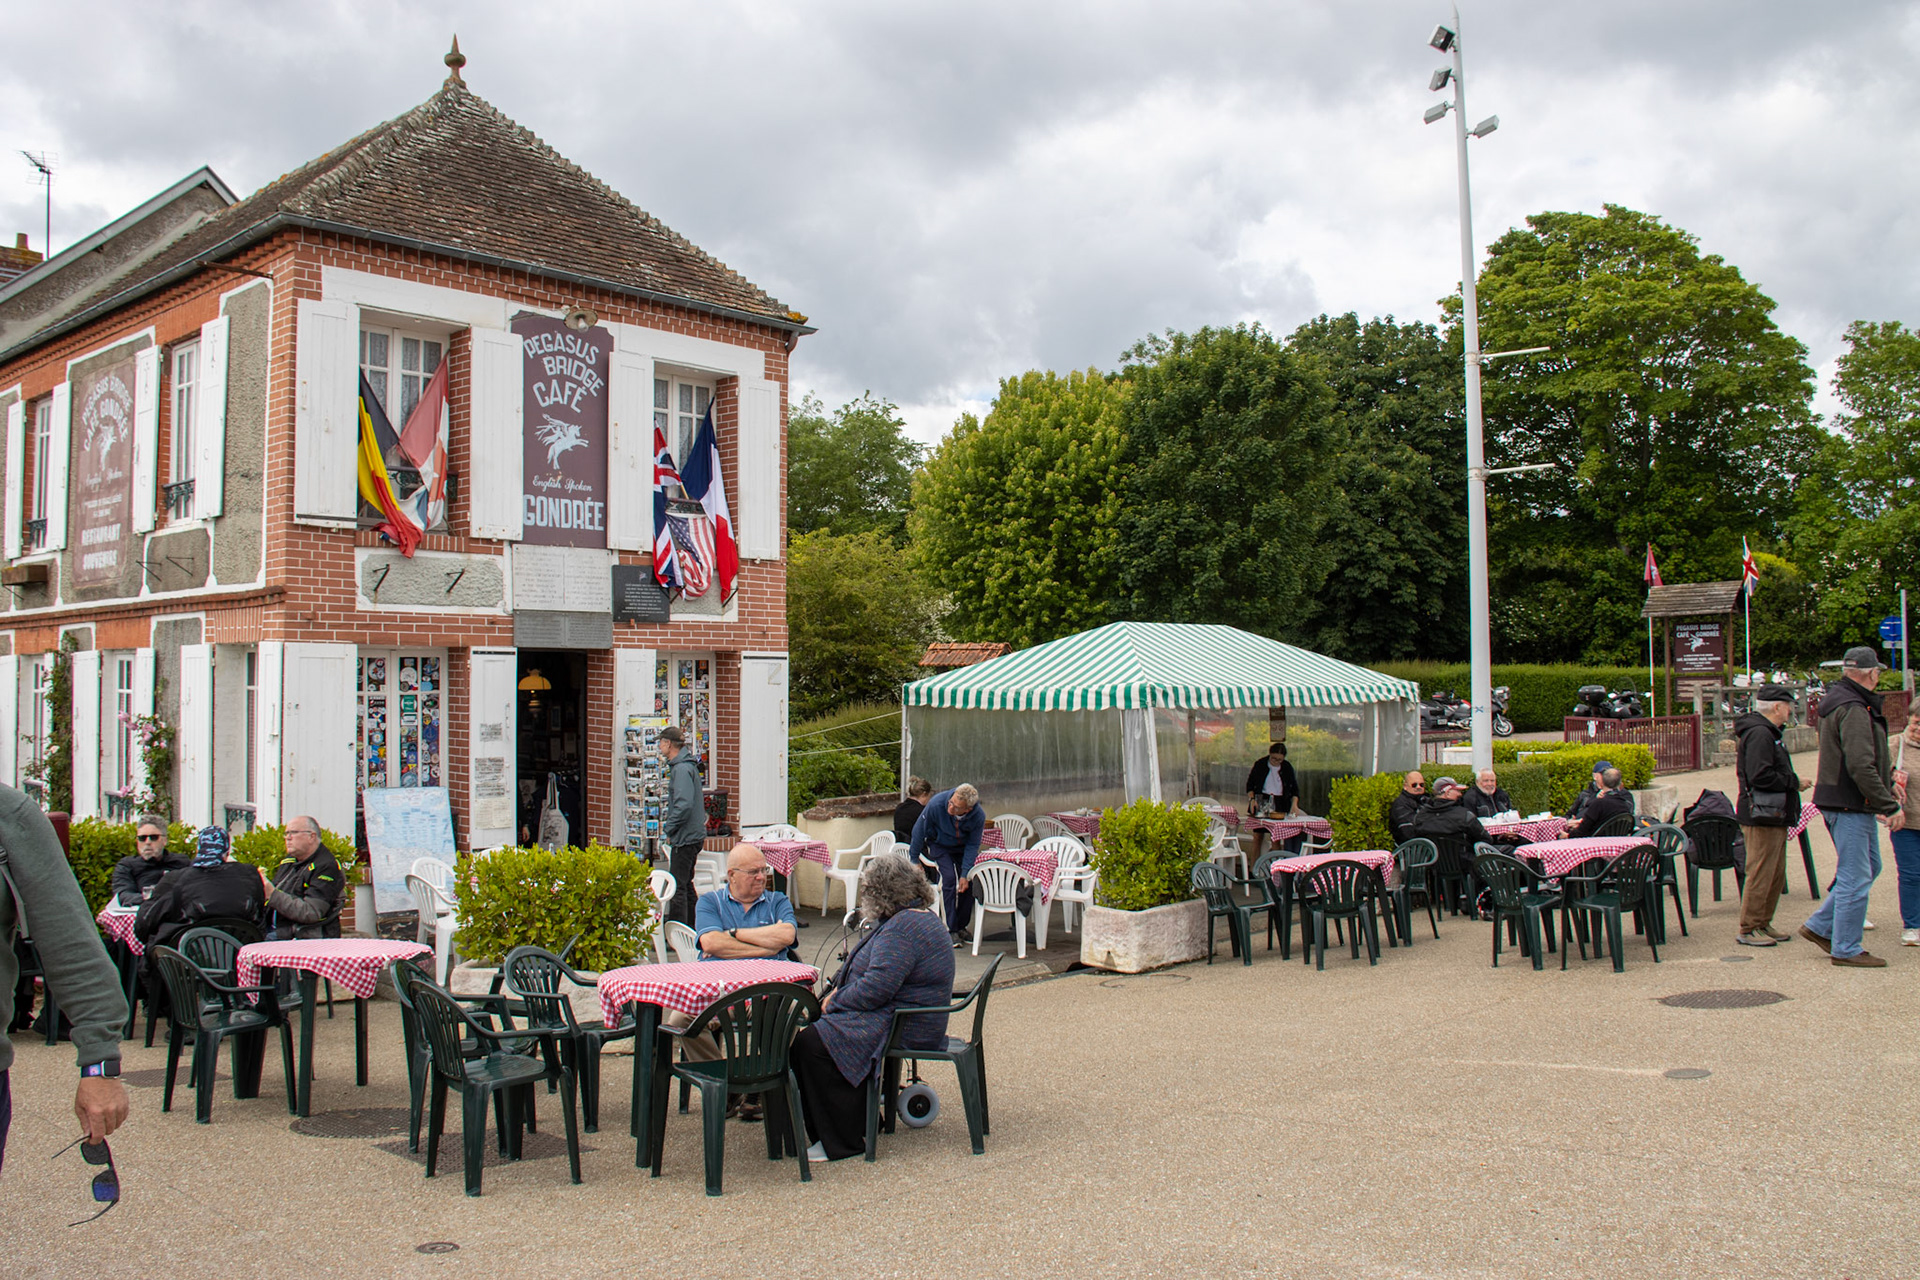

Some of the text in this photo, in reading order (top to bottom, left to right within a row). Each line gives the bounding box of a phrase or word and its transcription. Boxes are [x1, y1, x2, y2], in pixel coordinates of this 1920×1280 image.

[523, 332, 599, 365] PEGASUS
[543, 355, 604, 397] BRIDGE
[532, 379, 587, 413] CAFÉ
[532, 475, 593, 492] English Spoken
[523, 494, 604, 531] GONDRÉE
